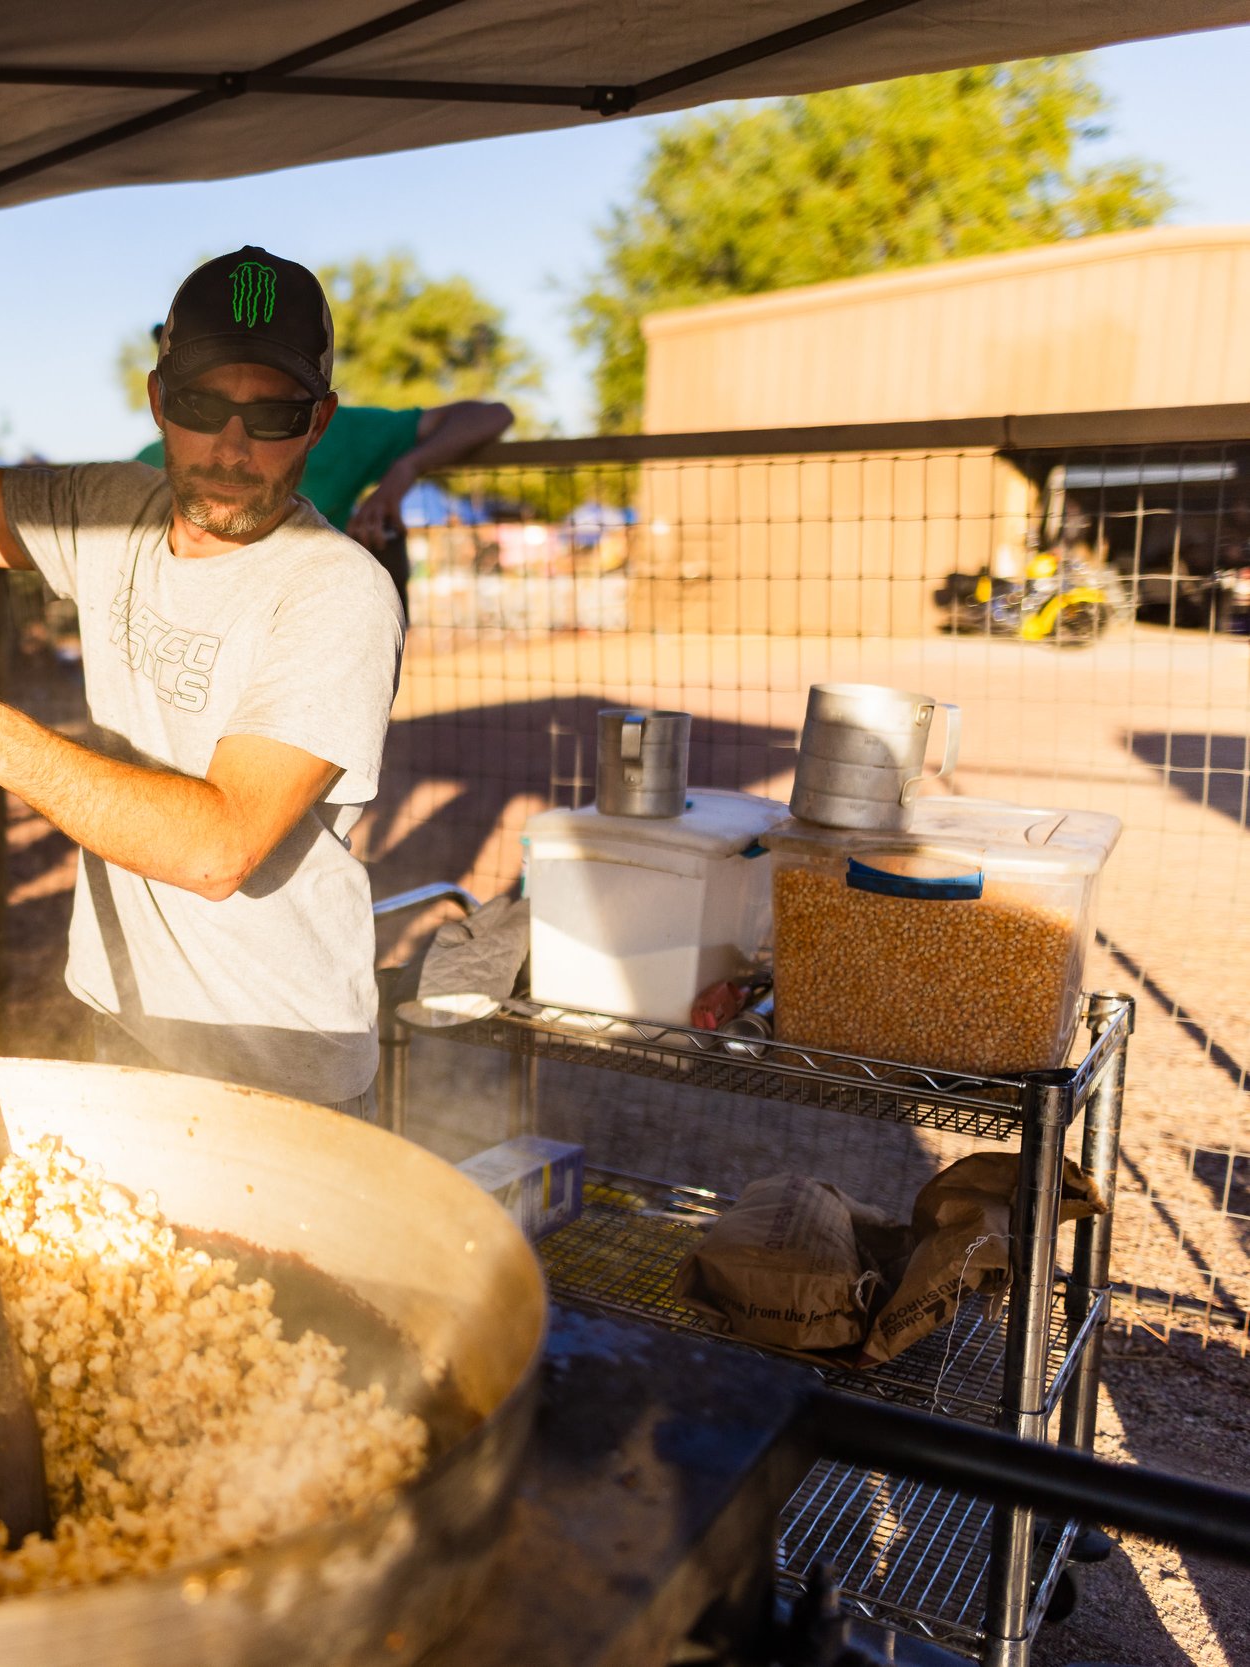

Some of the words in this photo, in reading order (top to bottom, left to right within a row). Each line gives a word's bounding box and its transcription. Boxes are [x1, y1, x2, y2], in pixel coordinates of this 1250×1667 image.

[748, 1303, 781, 1320] from
[784, 1308, 805, 1323] the
[878, 1278, 966, 1331] MUSHROOM
